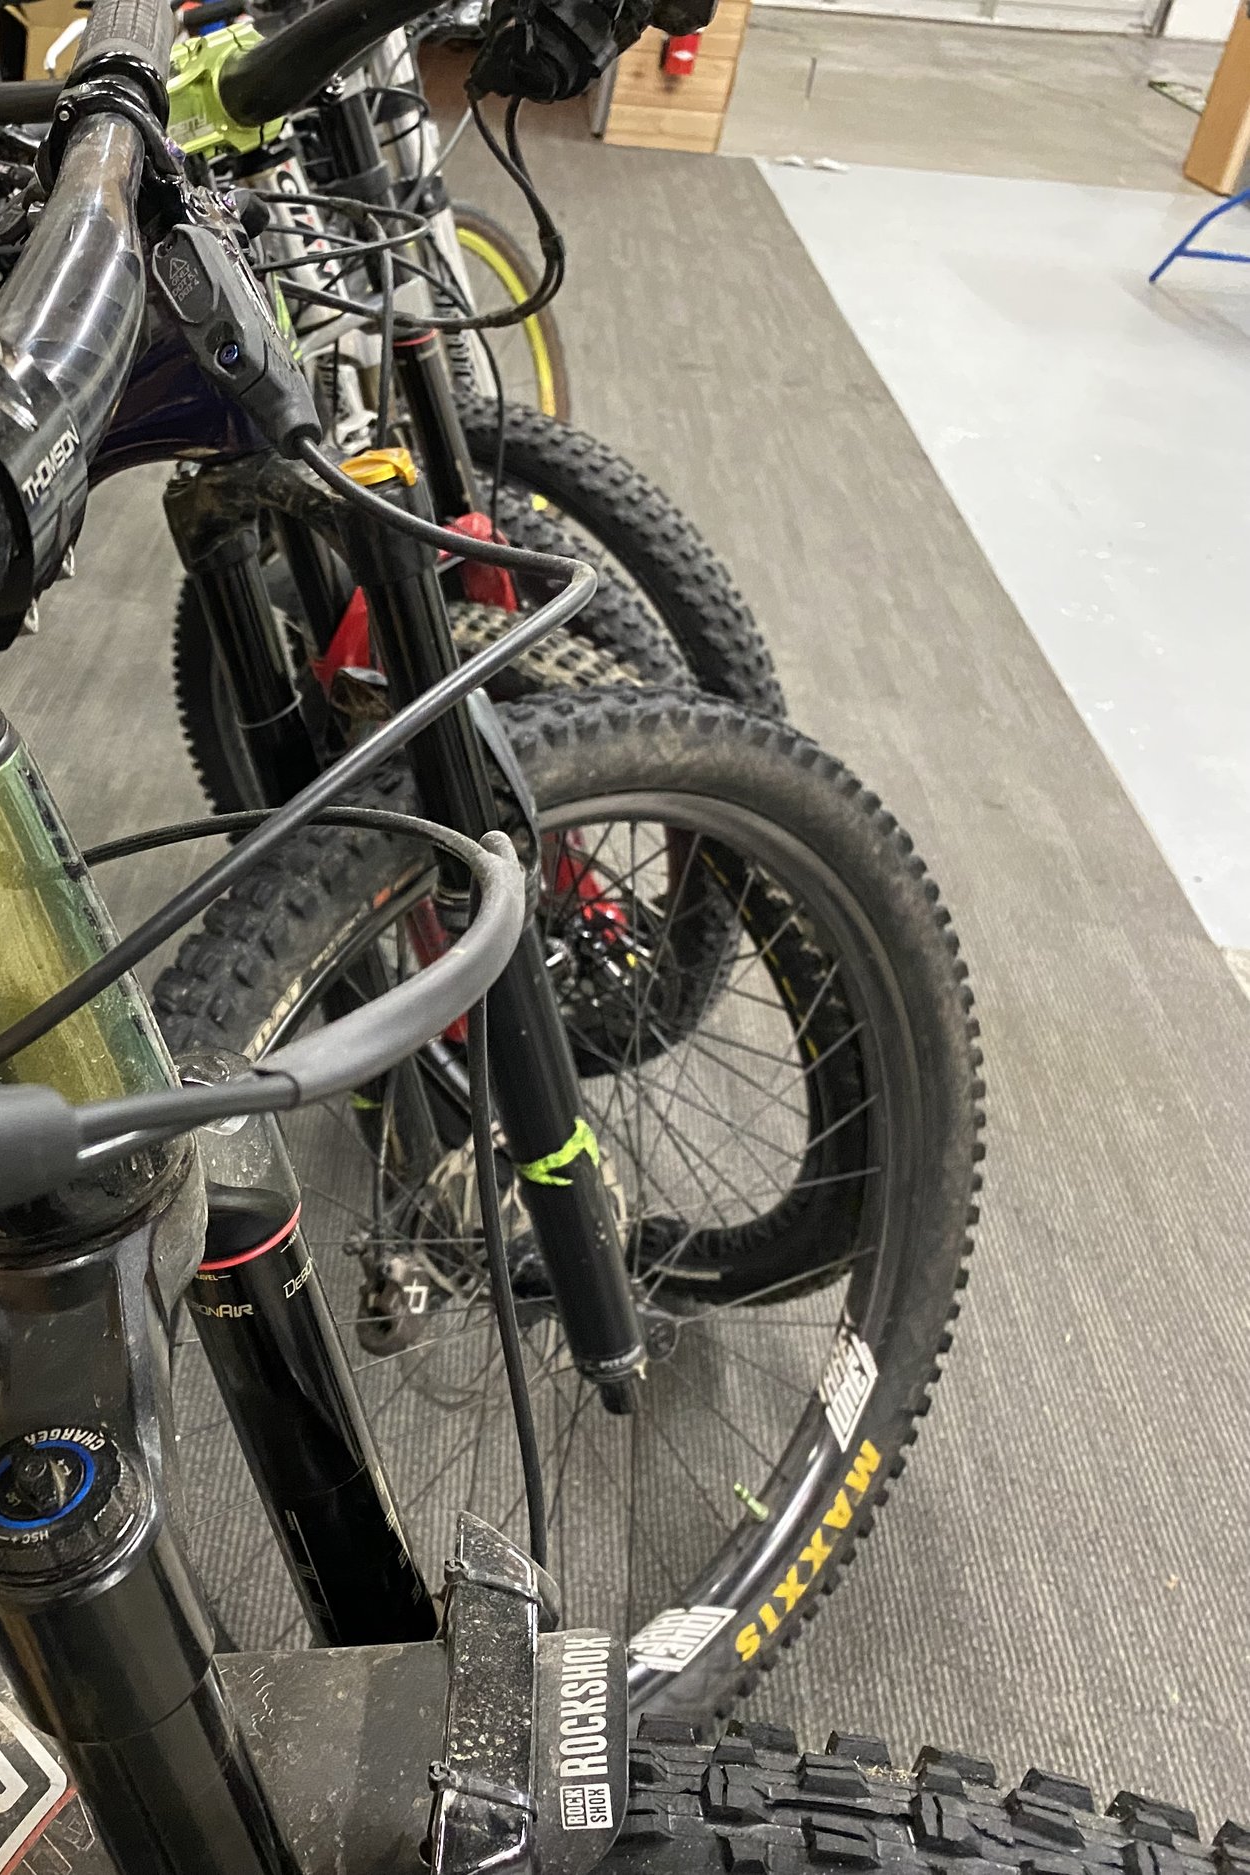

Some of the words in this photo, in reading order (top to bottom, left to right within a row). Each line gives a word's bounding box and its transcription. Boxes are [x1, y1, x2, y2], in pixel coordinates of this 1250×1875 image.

[21, 414, 80, 505] THOMSON
[24, 1427, 106, 1451] CHARGER
[735, 1439, 882, 1662] MAXXIS
[559, 1636, 612, 1778] ROCKSHOX
[565, 1787, 586, 1826] ROCK
[588, 1788, 608, 1823] SHOX
